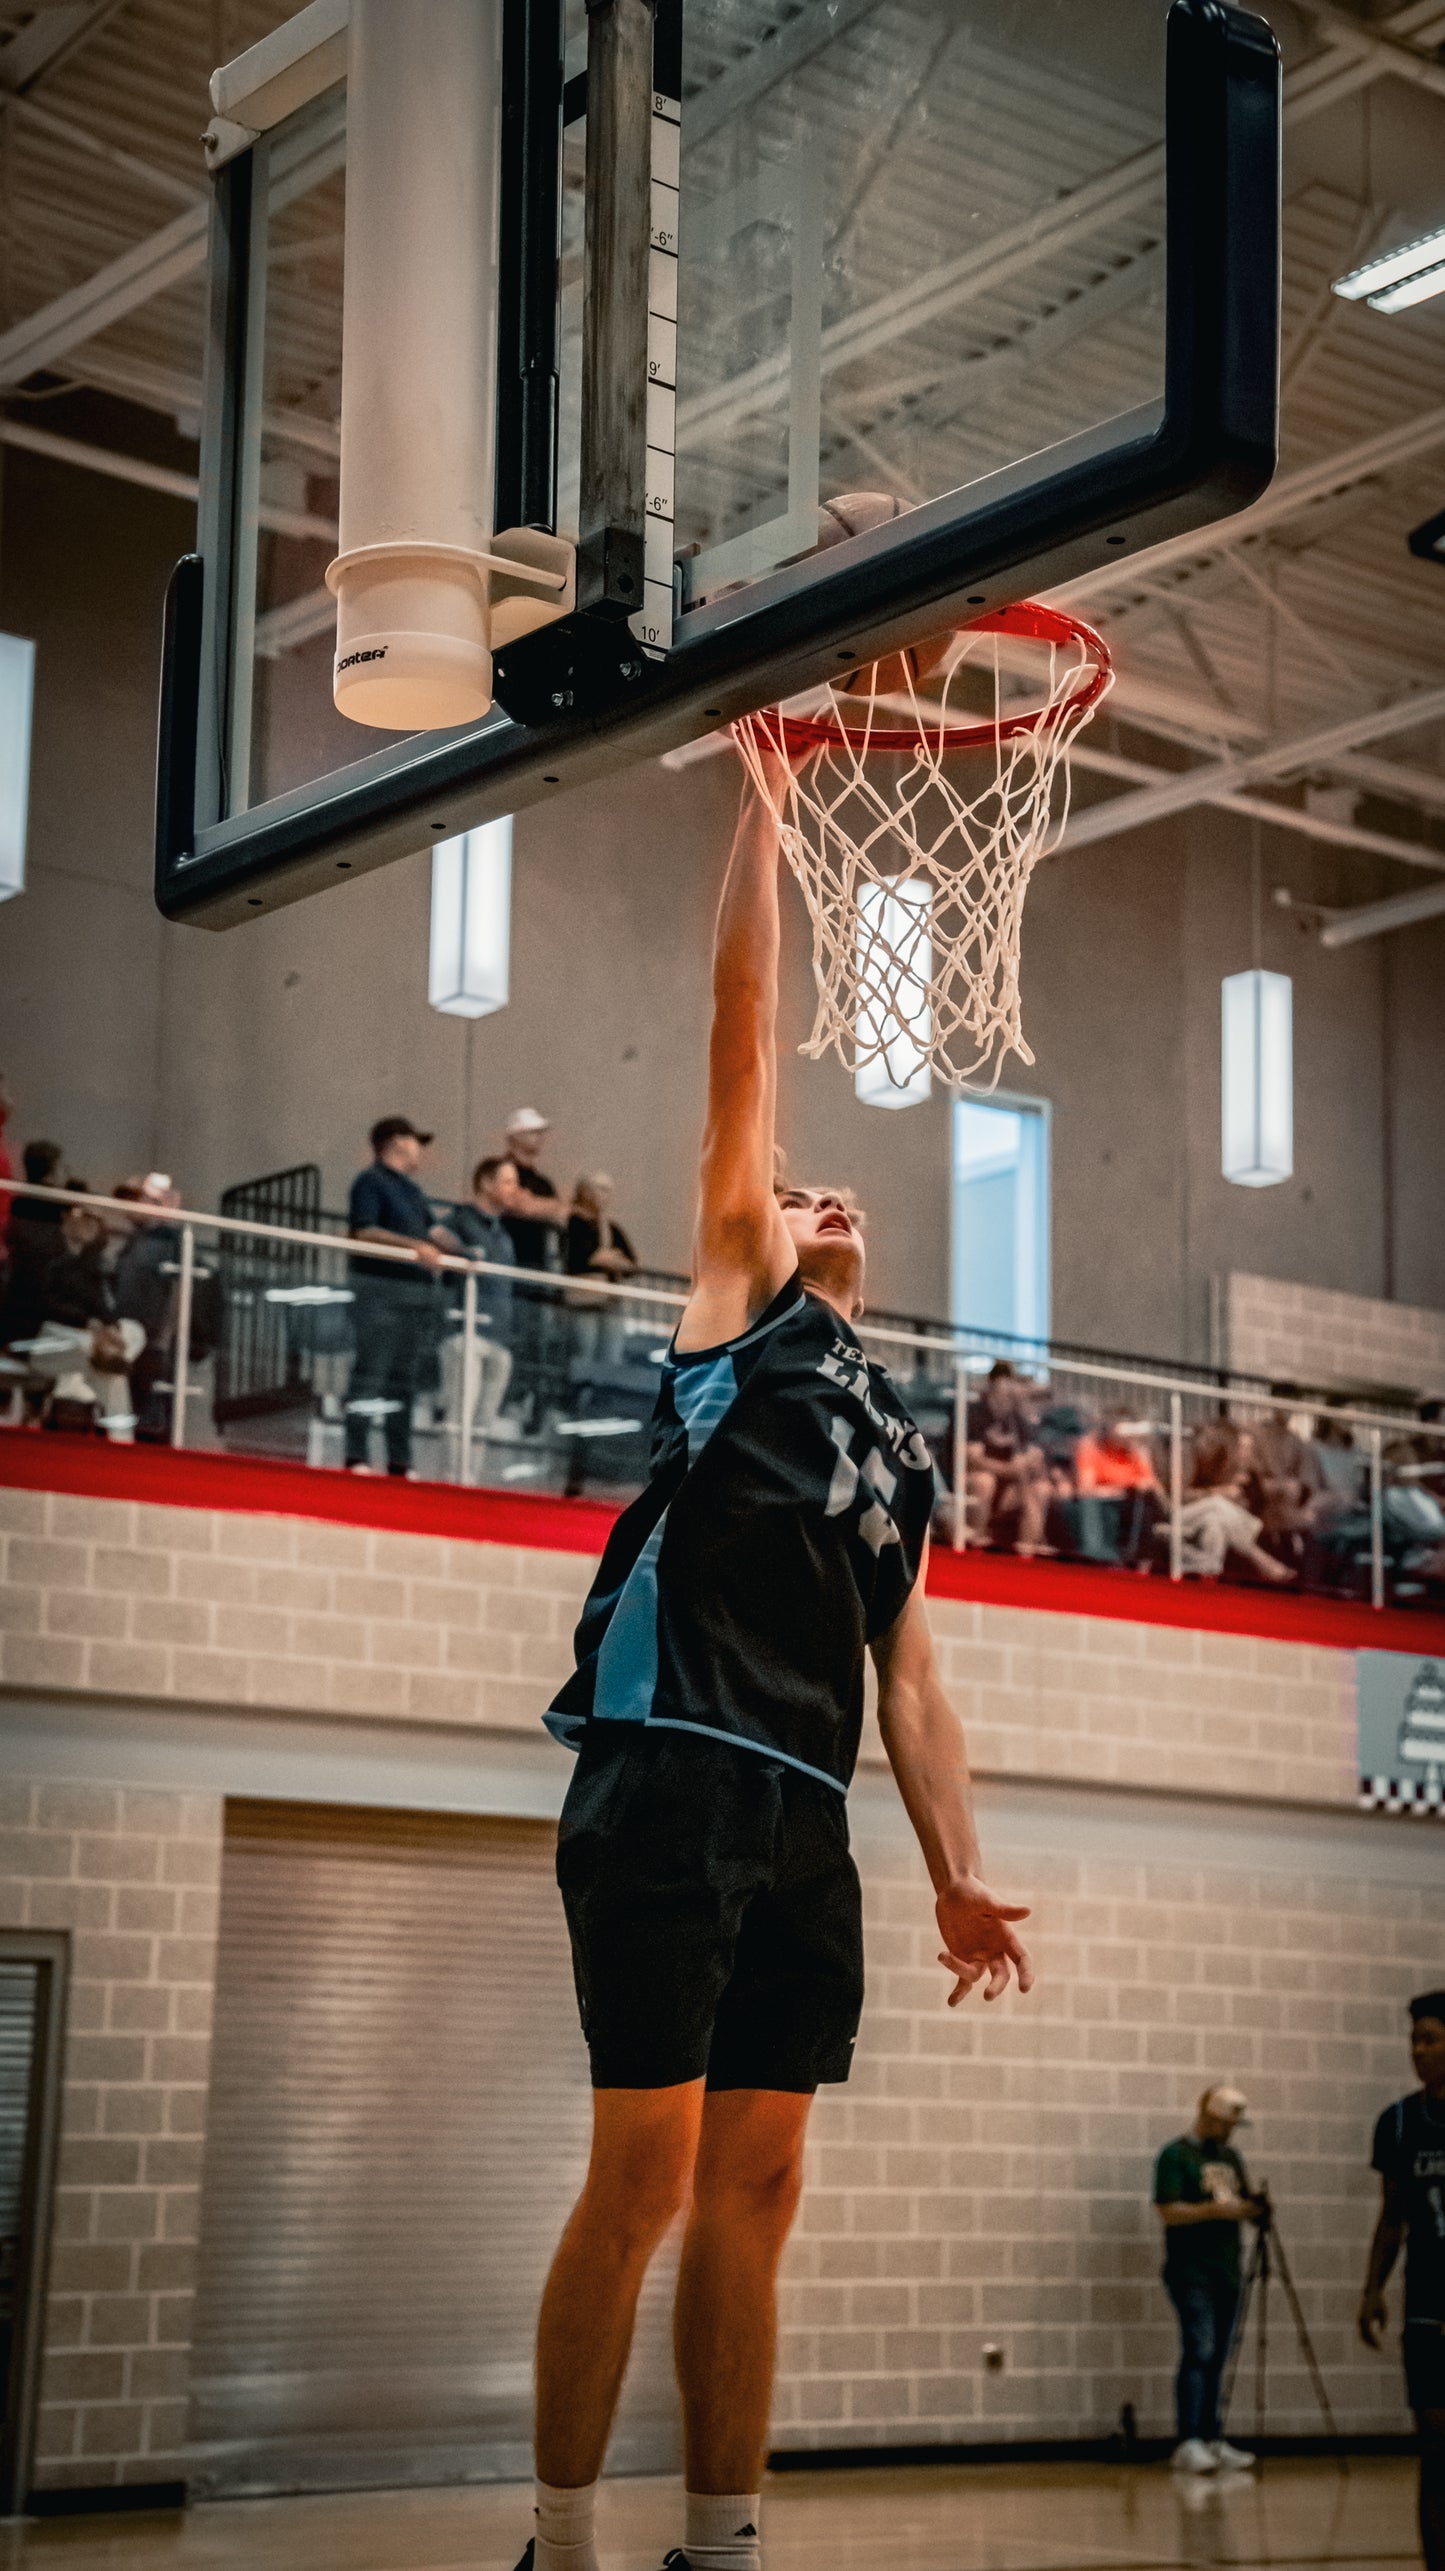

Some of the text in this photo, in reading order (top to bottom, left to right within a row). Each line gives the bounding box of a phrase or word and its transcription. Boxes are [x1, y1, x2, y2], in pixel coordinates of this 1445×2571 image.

[655, 96, 667, 111] 8'
[650, 226, 673, 246] '-6"
[649, 361, 661, 376] 9'
[645, 493, 668, 511] '-6"
[641, 625, 660, 643] 10'
